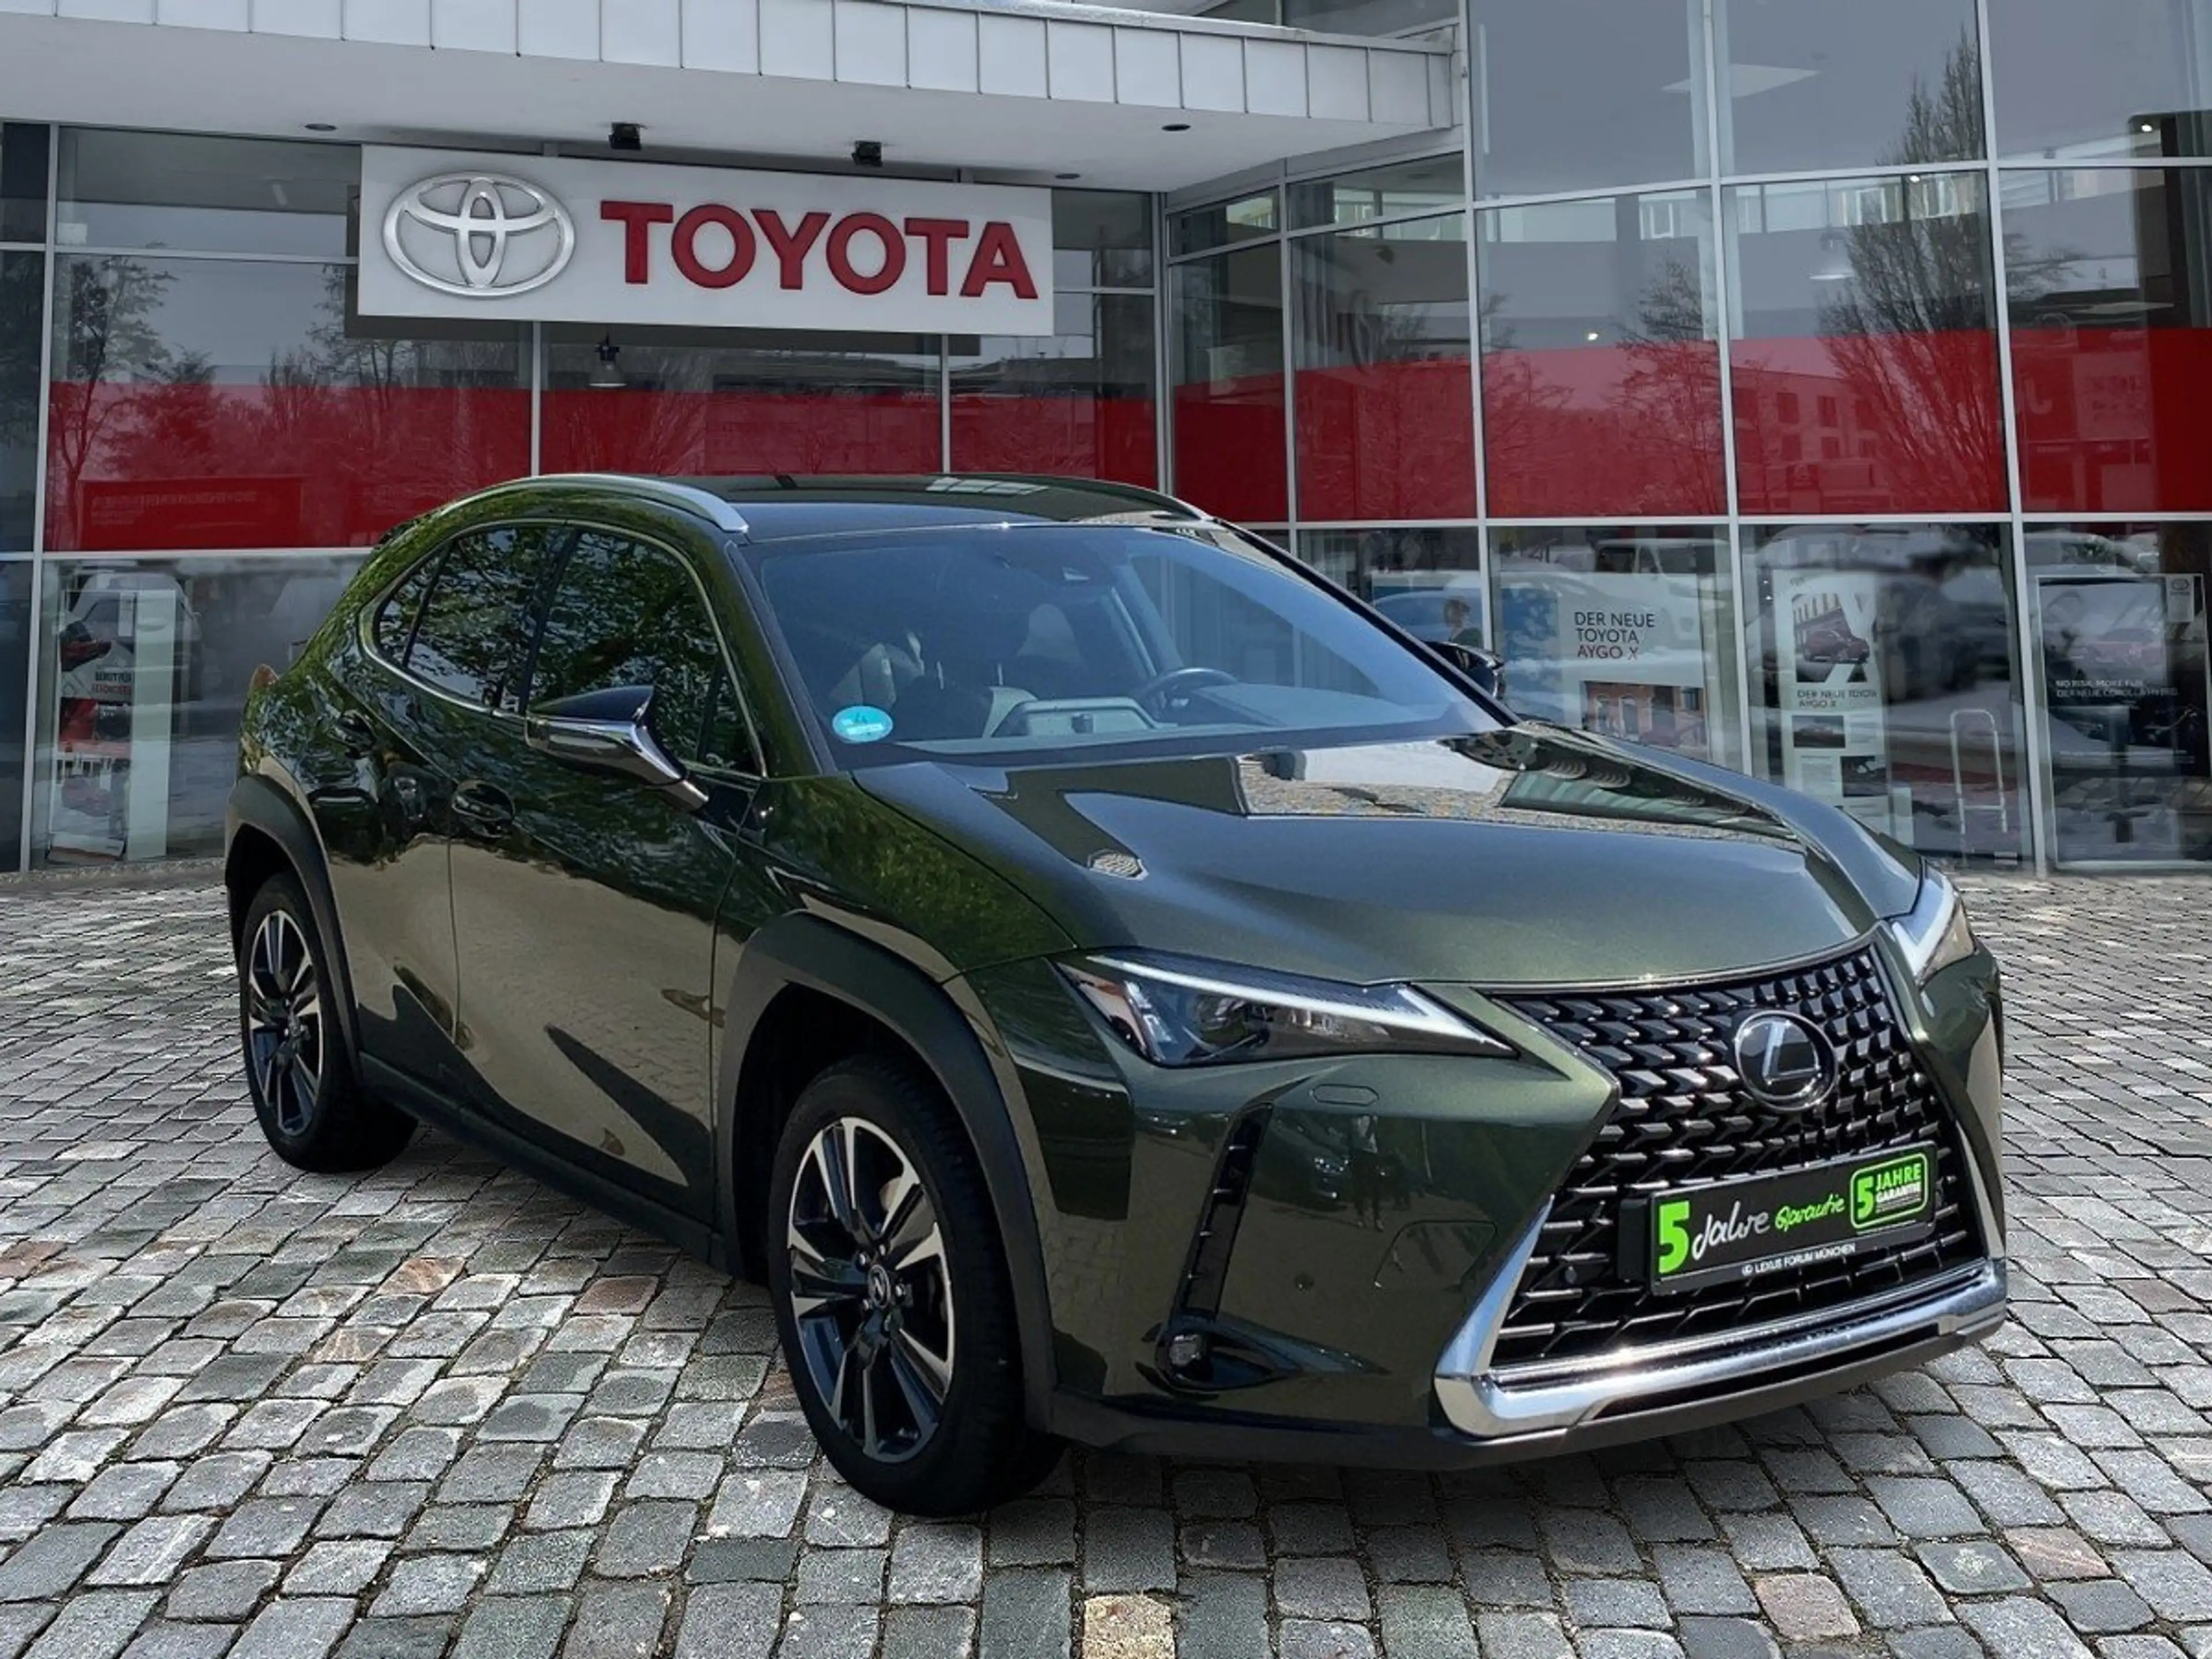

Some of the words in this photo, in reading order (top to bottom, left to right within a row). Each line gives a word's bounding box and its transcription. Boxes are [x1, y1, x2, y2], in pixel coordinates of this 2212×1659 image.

[601, 199, 1039, 300] TOYOTA
[1574, 611, 1607, 627] DER
[1611, 612, 1656, 628] NEUE
[1576, 628, 1639, 643] TOYOTA
[1577, 645, 1623, 660] AYGO
[1627, 646, 1639, 661] X
[1797, 690, 1817, 698] DER
[1821, 690, 1845, 699] NEUE
[1857, 1176, 1874, 1219] 5
[1875, 1163, 1922, 1191] JAHRE
[1659, 1200, 1690, 1274] 5
[1691, 1200, 1771, 1261] Jahre
[1755, 1258, 1782, 1274] LEXUS
[1784, 1252, 1813, 1267] FORUM
